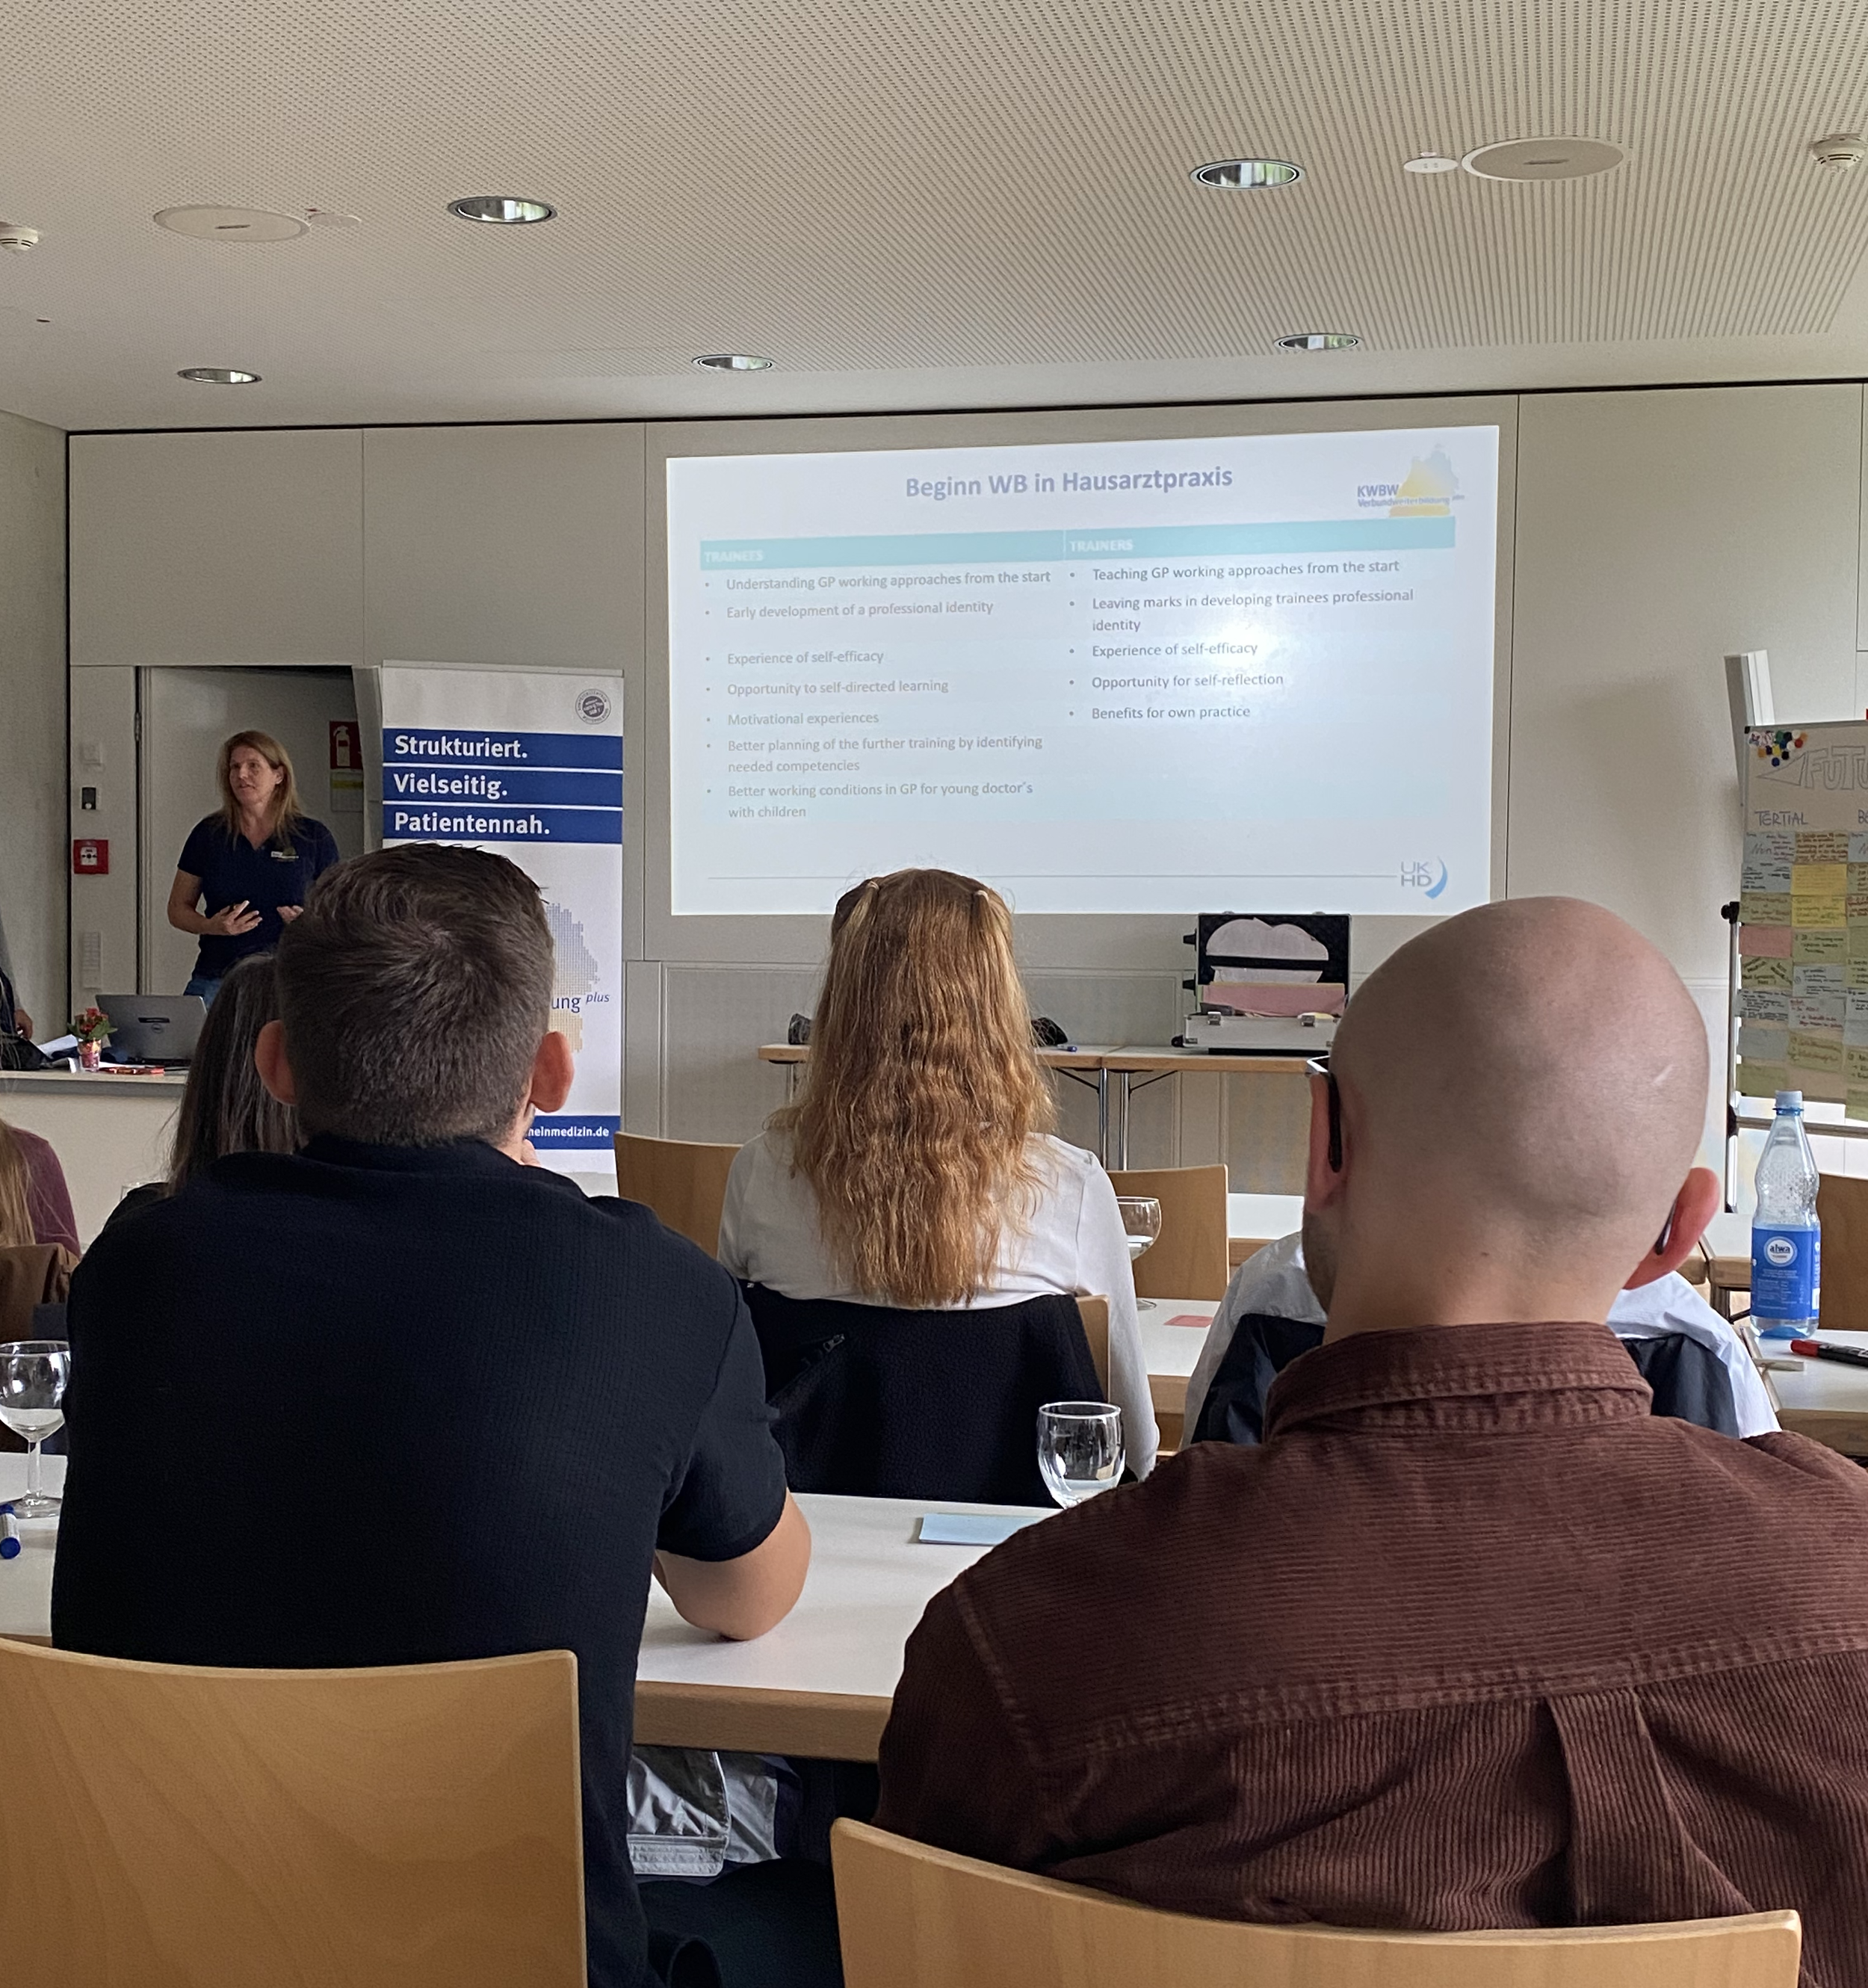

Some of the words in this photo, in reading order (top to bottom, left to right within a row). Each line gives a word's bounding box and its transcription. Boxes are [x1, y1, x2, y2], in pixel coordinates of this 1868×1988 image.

[906, 476, 981, 501] Beginn
[989, 475, 1027, 494] WB
[1035, 473, 1054, 493] in
[1063, 466, 1233, 493] Hausarztpraxis
[1357, 484, 1399, 497] KWBW
[1069, 538, 1134, 552] TRAINERS
[704, 549, 764, 563] TRAINEES
[1092, 568, 1148, 581] Teaching
[1151, 567, 1169, 578] GP
[1173, 566, 1224, 578] working
[1228, 564, 1303, 578] approaches
[1308, 562, 1338, 573] from
[1343, 561, 1365, 572] the
[1369, 561, 1400, 572] start
[726, 577, 815, 590] Understanding
[818, 576, 835, 587] GP
[838, 575, 888, 589] working
[891, 572, 962, 588] approaches
[965, 572, 995, 584] from
[998, 572, 1019, 583] the
[1022, 572, 1051, 582] start
[1093, 597, 1139, 611] Leaving
[1144, 596, 1182, 608] marks
[1186, 595, 1197, 607] in
[1201, 593, 1272, 608] developing
[1276, 593, 1329, 604] trainees
[1333, 589, 1413, 605] professional
[727, 607, 756, 620] Early
[759, 605, 839, 619] development
[842, 604, 855, 615] of
[858, 606, 865, 615] a
[869, 602, 942, 617] professional
[946, 601, 994, 615] identity
[1093, 620, 1141, 632] identity
[728, 652, 793, 667] Experience
[796, 652, 809, 663] of
[811, 650, 884, 664] self-efficacy
[1092, 645, 1161, 659] Experience
[1165, 643, 1178, 655] of
[1181, 643, 1258, 655] self-efficacy
[727, 683, 801, 697] Opportunity
[803, 684, 817, 694] to
[820, 680, 895, 693] self-directed
[899, 679, 948, 693] learning
[1092, 676, 1169, 691] Opportunity
[1173, 675, 1191, 686] for
[1195, 673, 1283, 686] self-reflection
[729, 712, 803, 725] Motivational
[807, 711, 879, 726] experiences
[1092, 707, 1143, 719] Benefits
[1147, 707, 1165, 718] for
[1168, 709, 1195, 717] own
[1200, 706, 1250, 720] practice
[395, 735, 527, 758] Strukturiert.
[729, 741, 765, 751] Better
[768, 739, 820, 753] planning
[823, 738, 836, 750] of
[839, 738, 859, 750] the
[862, 738, 906, 749] further
[909, 737, 956, 750] training
[959, 737, 974, 751] by
[977, 735, 1042, 750] identifying
[729, 760, 773, 773] needed
[776, 759, 859, 774] competencies
[394, 773, 508, 800] Vielseitig.
[729, 786, 765, 797] Better
[768, 785, 816, 798] working
[820, 784, 882, 795] conditions
[885, 783, 897, 794] in
[900, 783, 917, 794] GP
[921, 782, 938, 794] for
[941, 785, 979, 797] young
[729, 806, 754, 818] with
[758, 806, 805, 817] children
[1754, 810, 1808, 826] TERTIAL
[395, 812, 550, 835] Patientennah.
[1401, 861, 1429, 873] UK
[1401, 874, 1432, 886] HD
[586, 992, 610, 1005] plus
[1769, 1244, 1791, 1253] alwa
